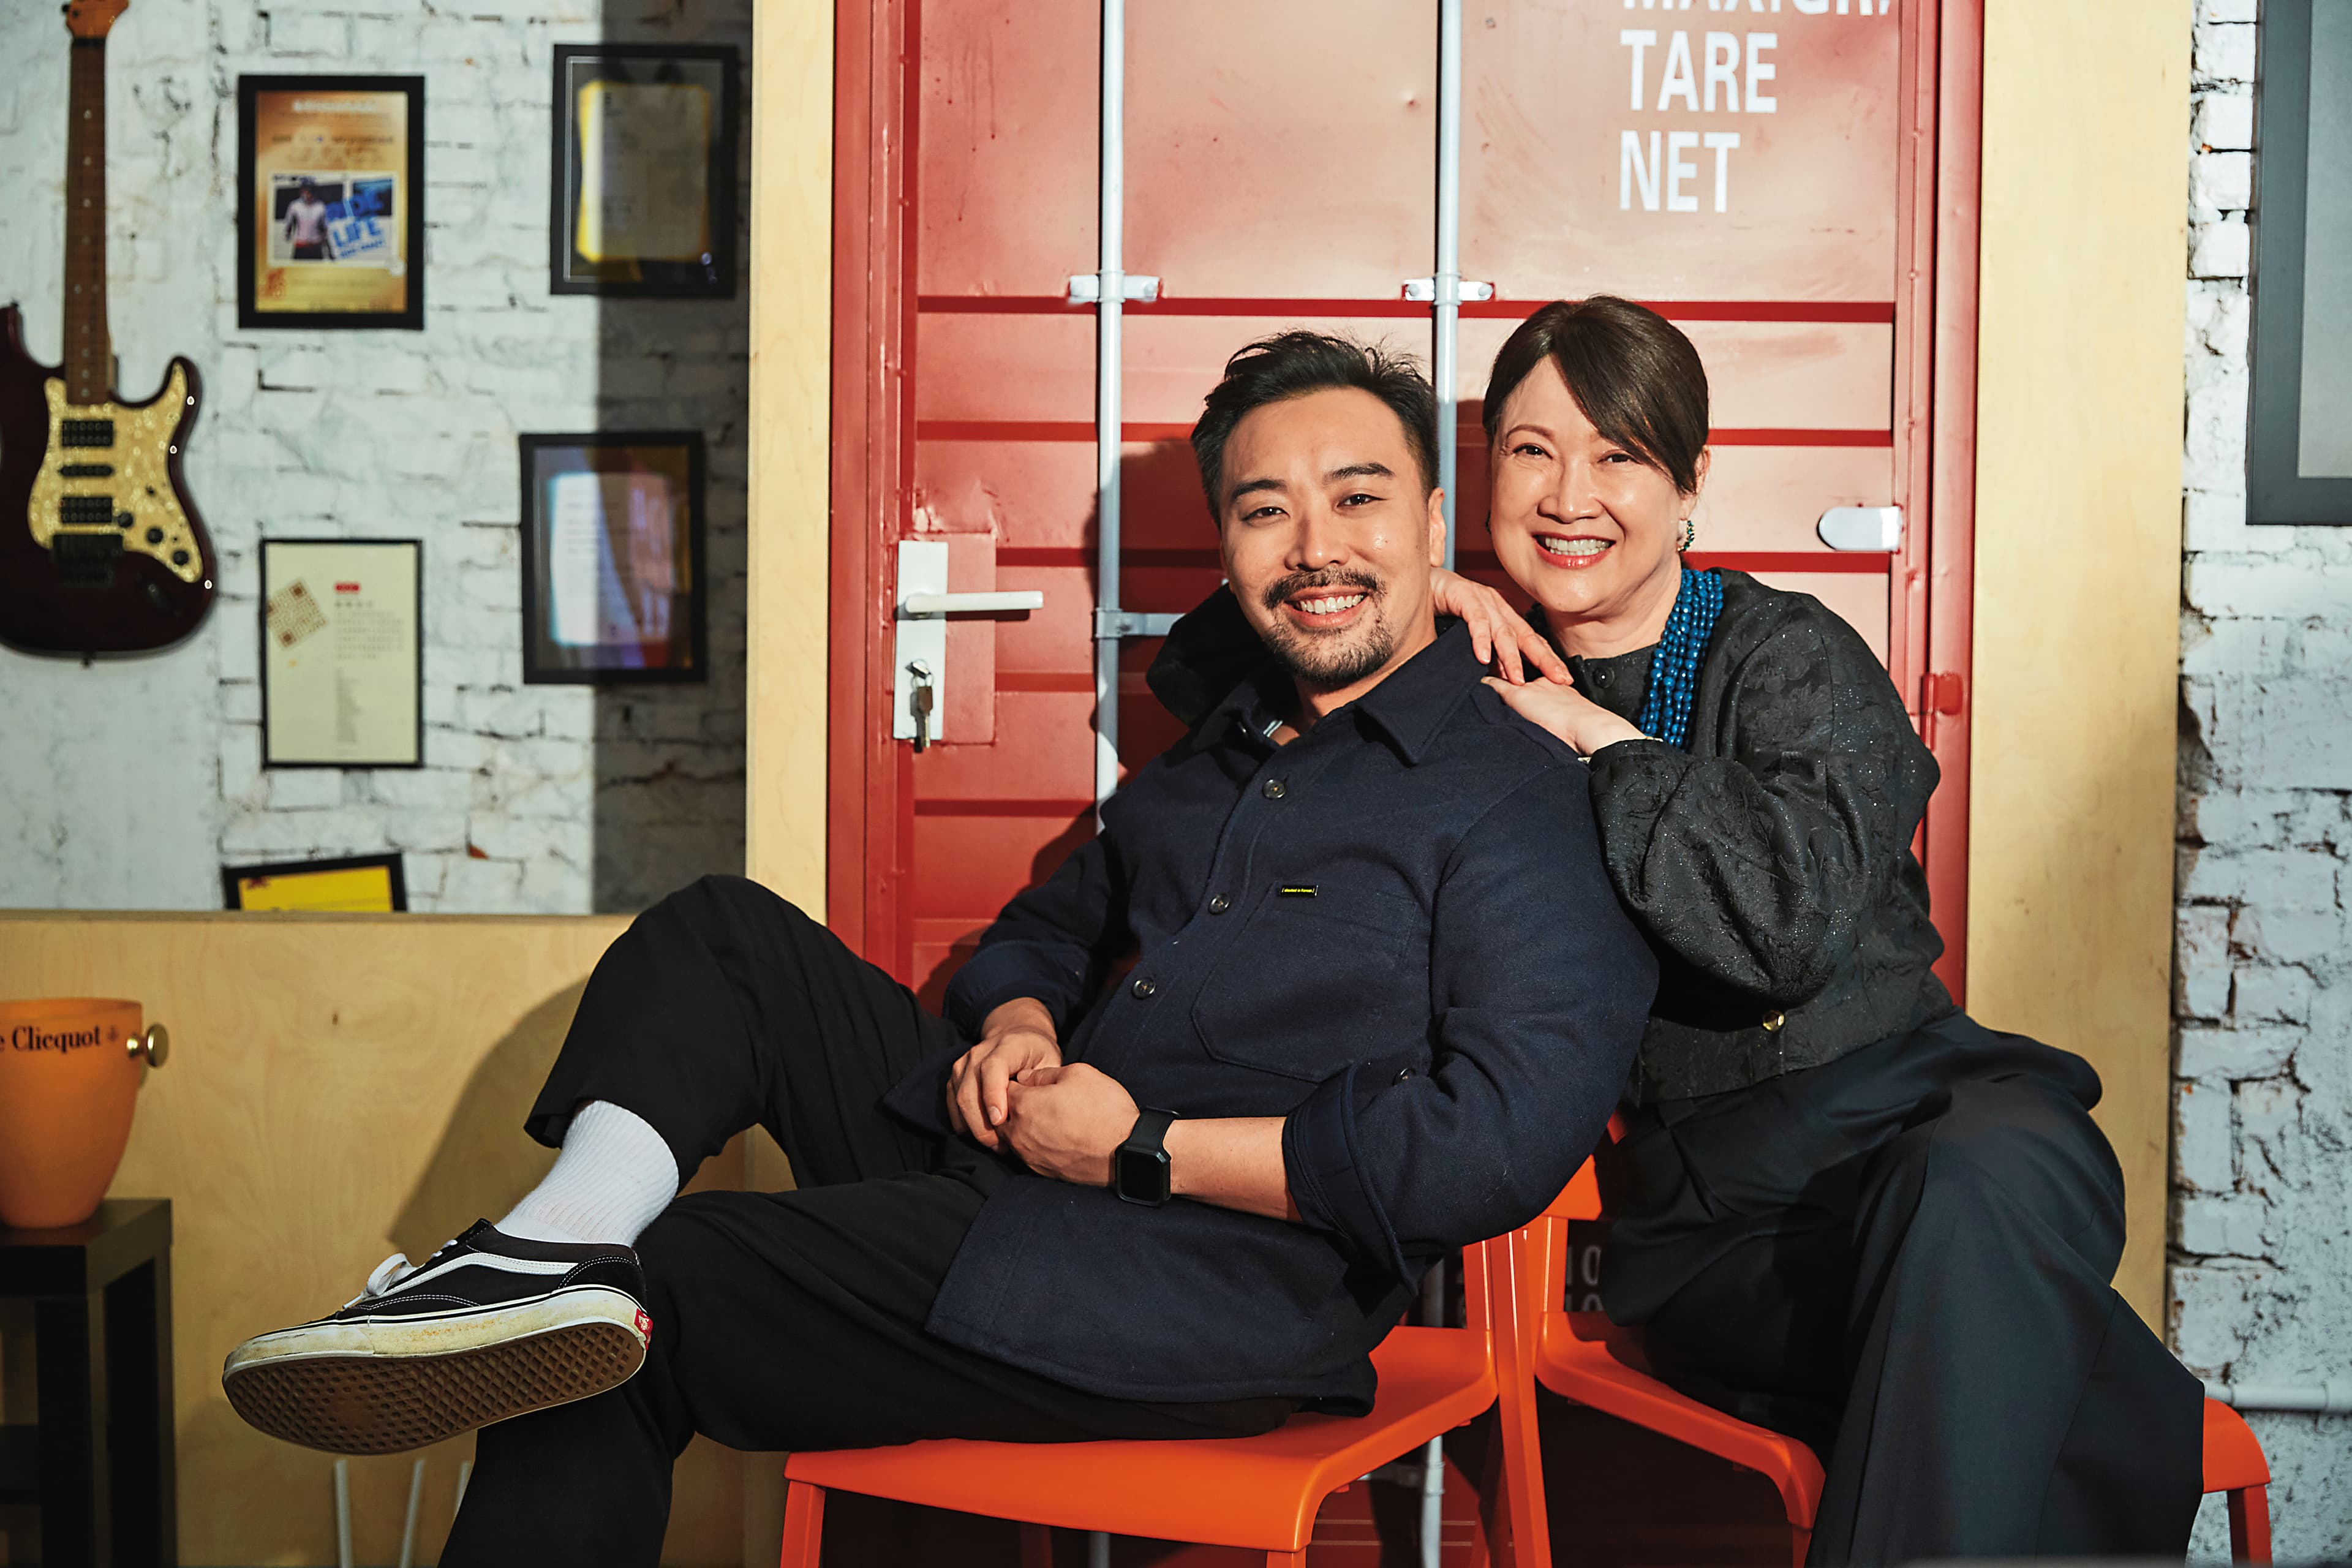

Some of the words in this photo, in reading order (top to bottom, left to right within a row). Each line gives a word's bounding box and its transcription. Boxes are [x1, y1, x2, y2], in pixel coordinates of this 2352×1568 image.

[1620, 29, 1777, 113] TARE
[1619, 130, 1740, 213] NET
[12, 1025, 100, 1054] Clicquot
